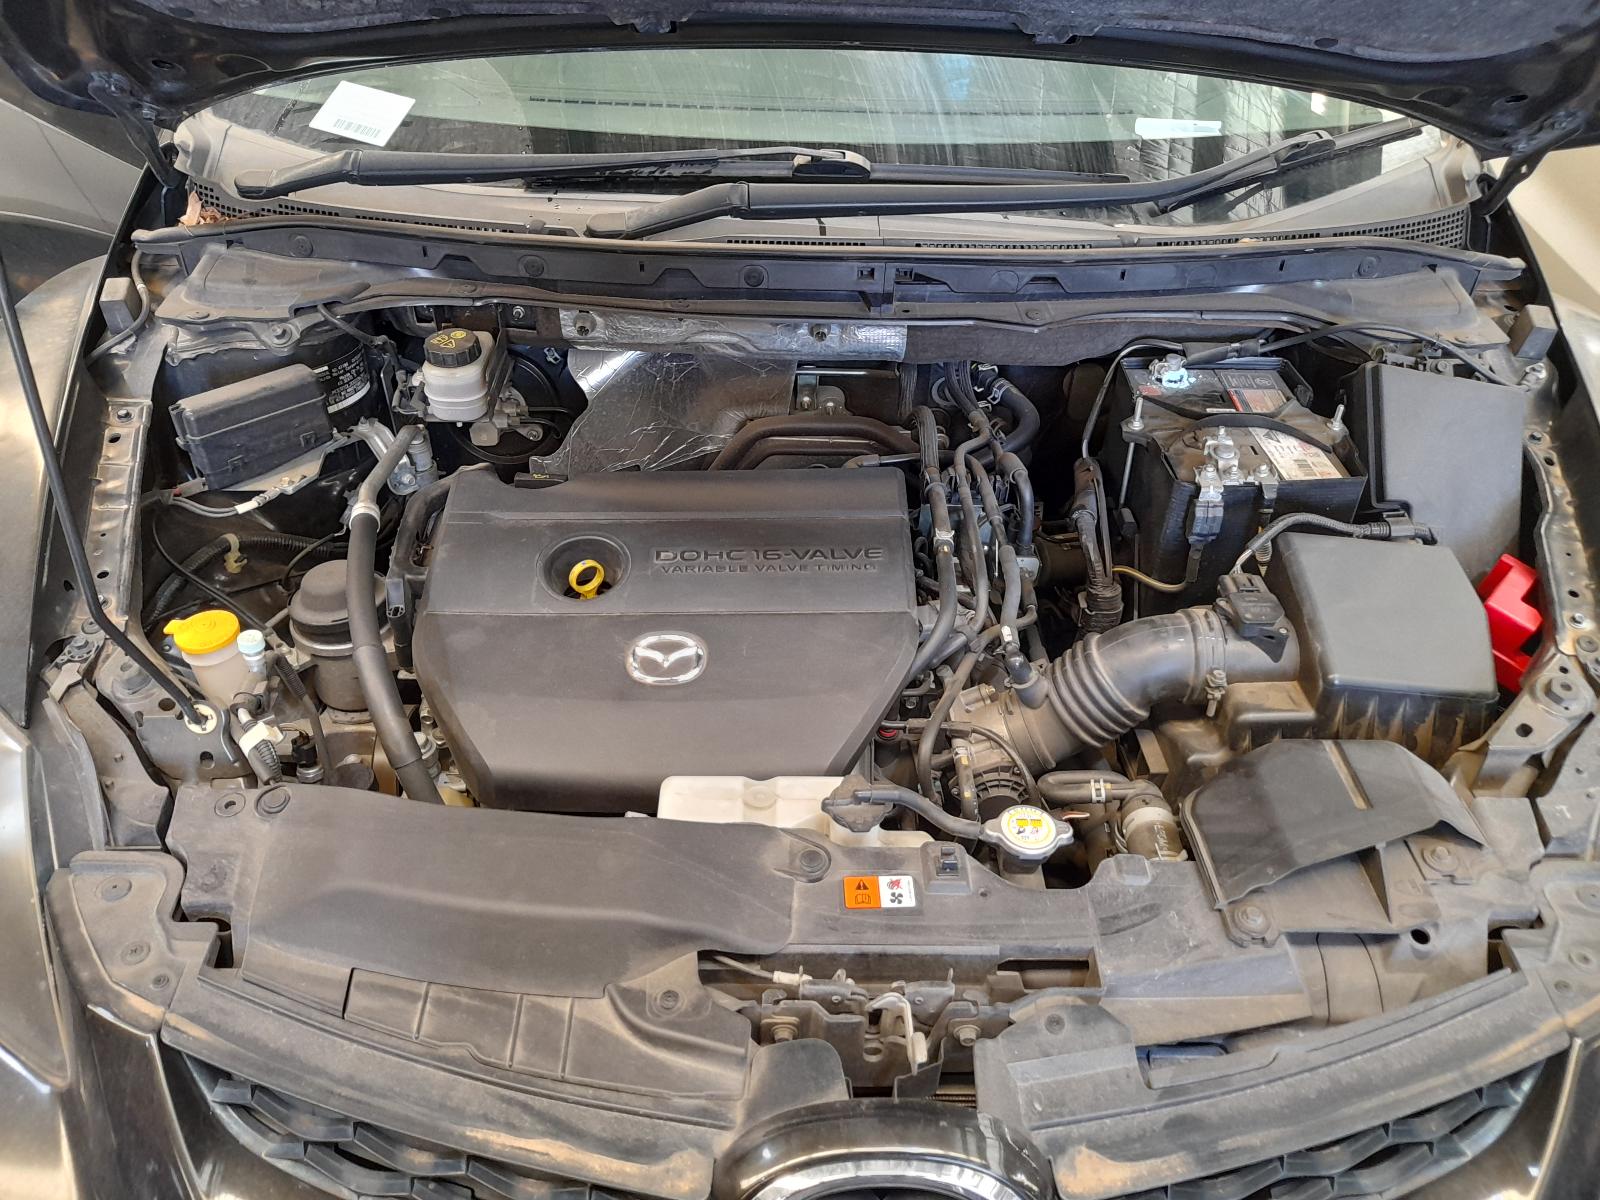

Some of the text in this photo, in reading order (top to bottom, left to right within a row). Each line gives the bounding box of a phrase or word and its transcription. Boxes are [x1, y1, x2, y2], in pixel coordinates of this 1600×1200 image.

[654, 547, 884, 562] DOHC 16-VALVE
[661, 562, 877, 574] VARIABLE VALVE TIMING
